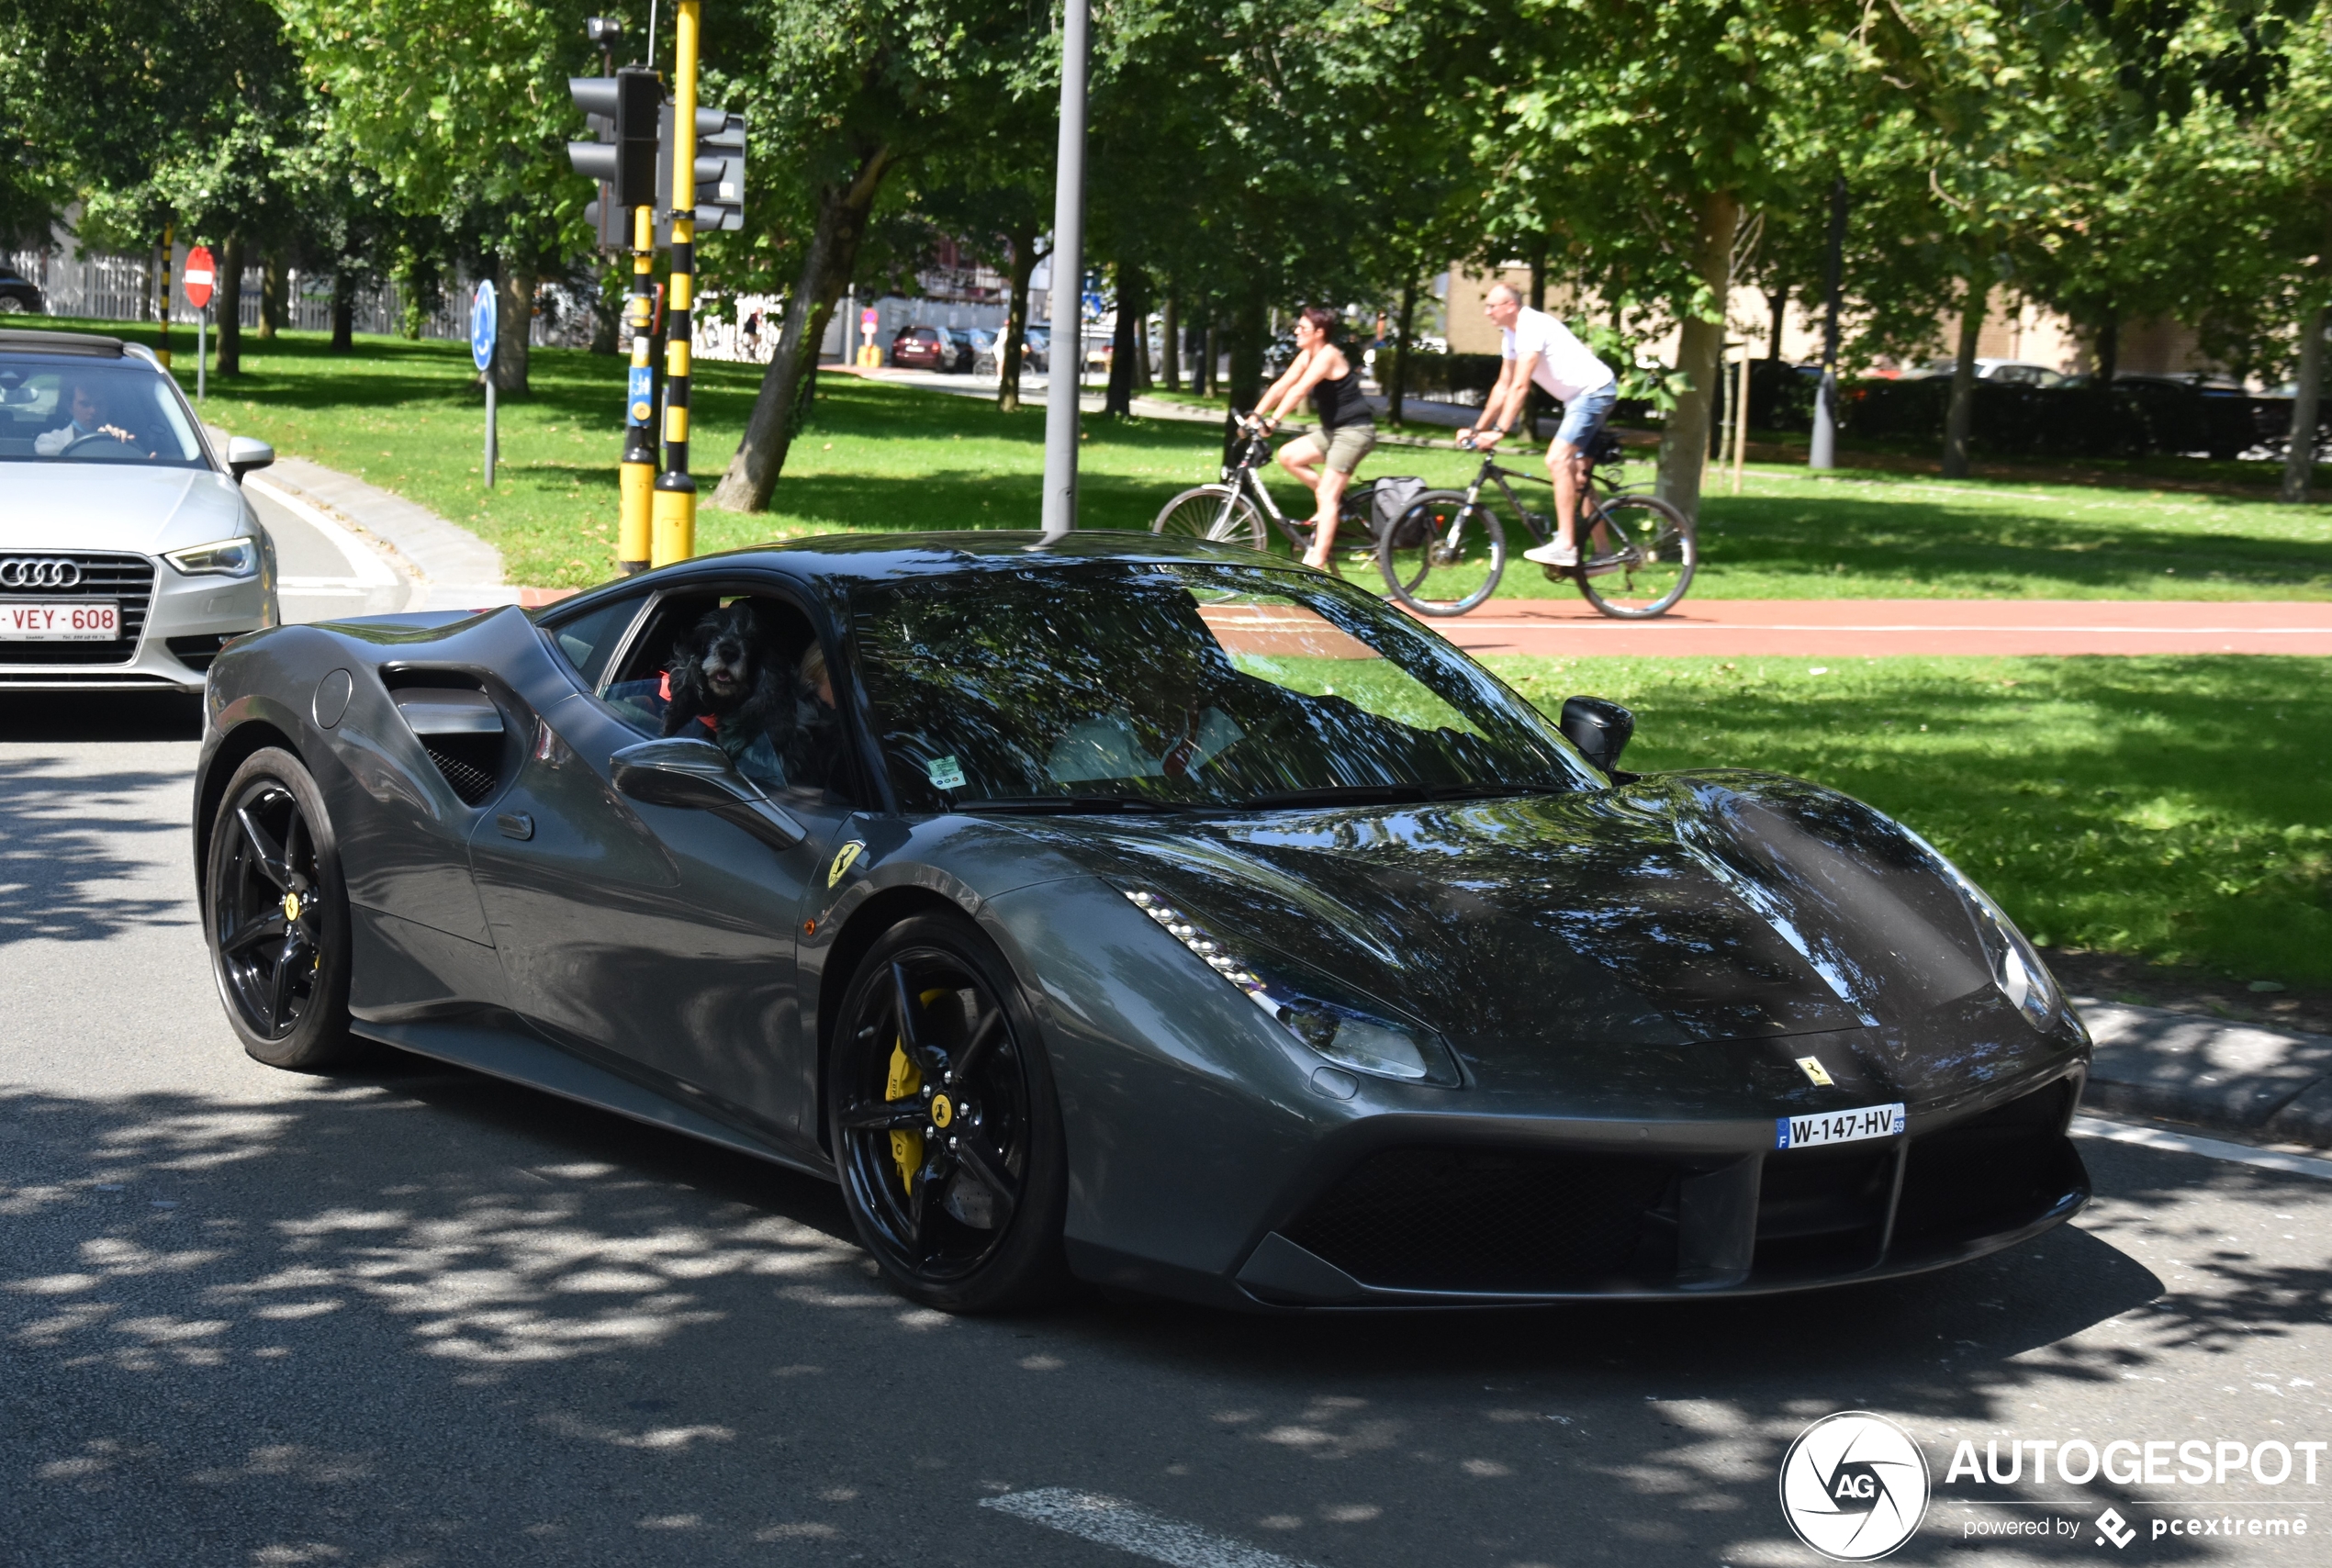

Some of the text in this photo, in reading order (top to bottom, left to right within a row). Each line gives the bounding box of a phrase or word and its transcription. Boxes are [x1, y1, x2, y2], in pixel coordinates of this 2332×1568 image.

[1792, 1110, 1892, 1143] W-147-HV
[1893, 1120, 1904, 1133] 59
[1778, 1136, 1787, 1148] F
